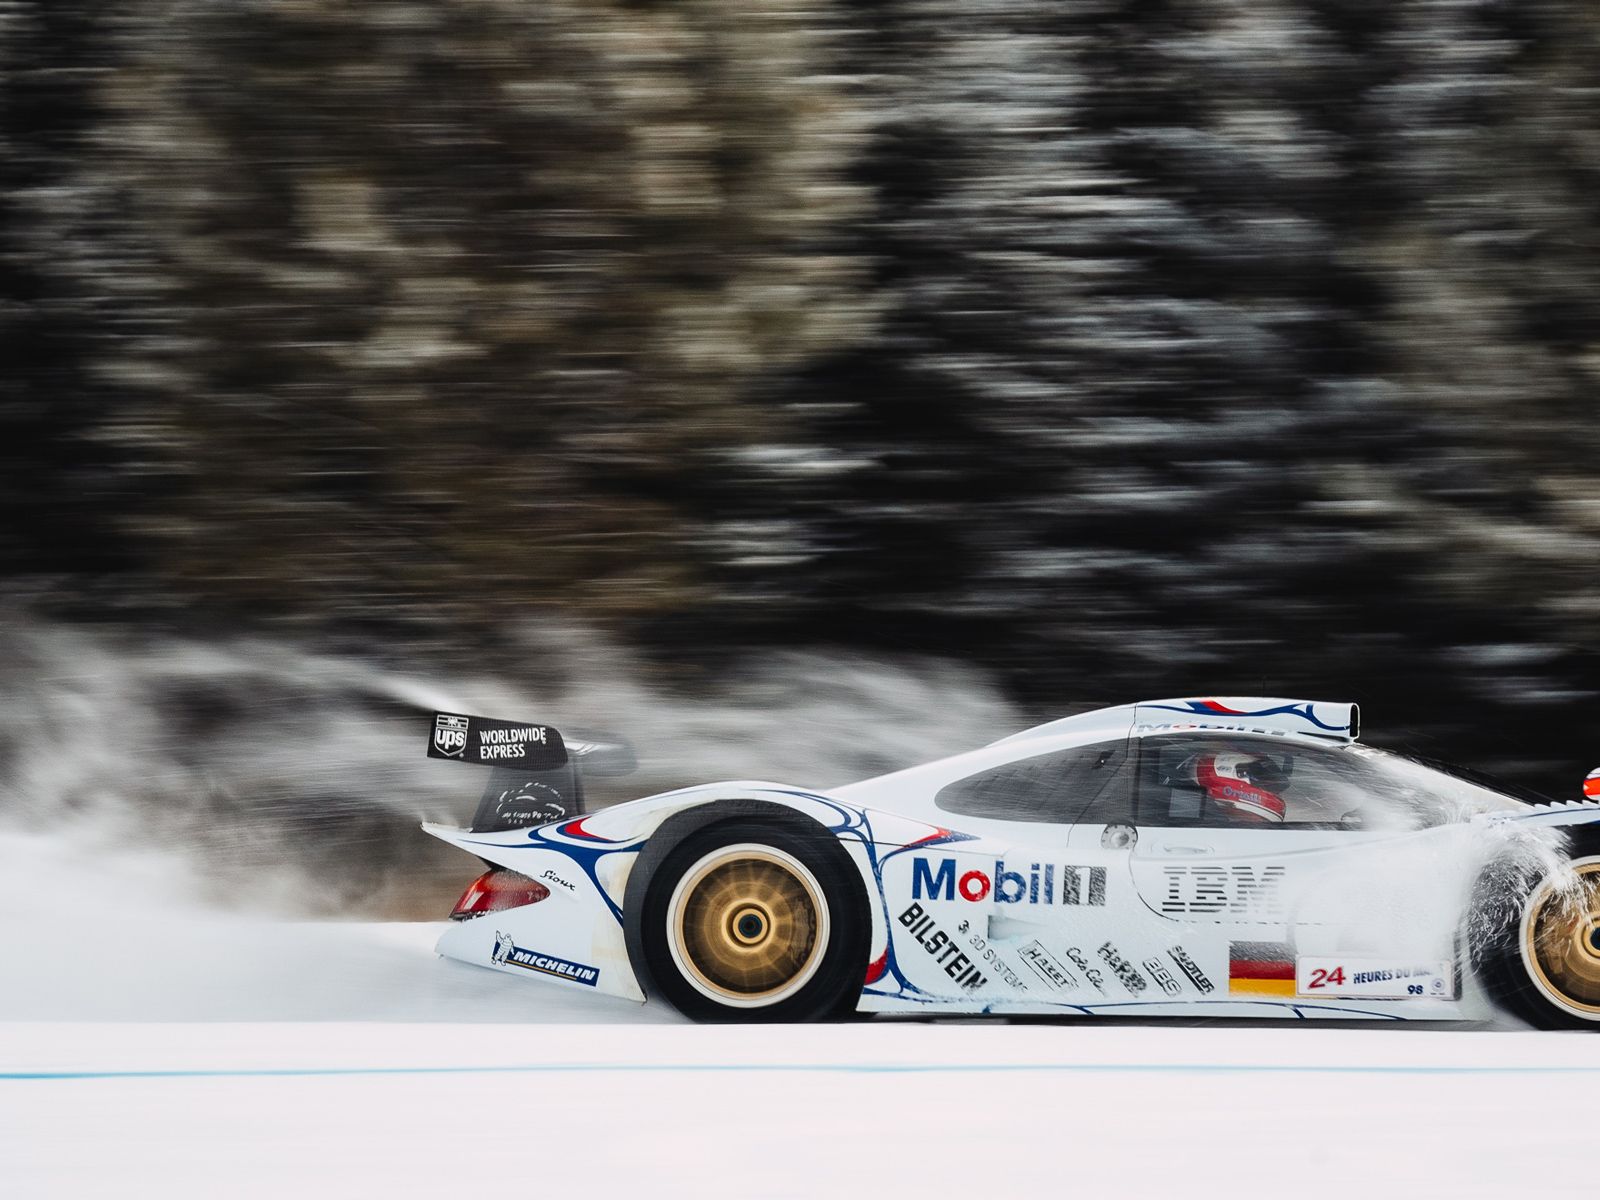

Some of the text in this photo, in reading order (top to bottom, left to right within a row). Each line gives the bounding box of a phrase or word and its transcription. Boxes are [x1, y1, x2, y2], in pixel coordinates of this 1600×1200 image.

[436, 729, 465, 749] ups
[479, 727, 546, 744] WORLDWIDE
[480, 744, 526, 759] EXPRESS
[540, 869, 576, 892] Sioux
[911, 857, 1055, 905] Mobil
[1162, 866, 1285, 913] IBM
[898, 901, 988, 994] BILSTEIN
[969, 934, 986, 951] 3D
[513, 951, 596, 980] MICHELIN
[1028, 947, 1069, 986] HAZET
[1142, 956, 1182, 997] BBS
[1307, 966, 1346, 990] 24
[1353, 969, 1393, 984] HEURES
[1395, 968, 1411, 979] DU
[1407, 984, 1424, 995] 98
